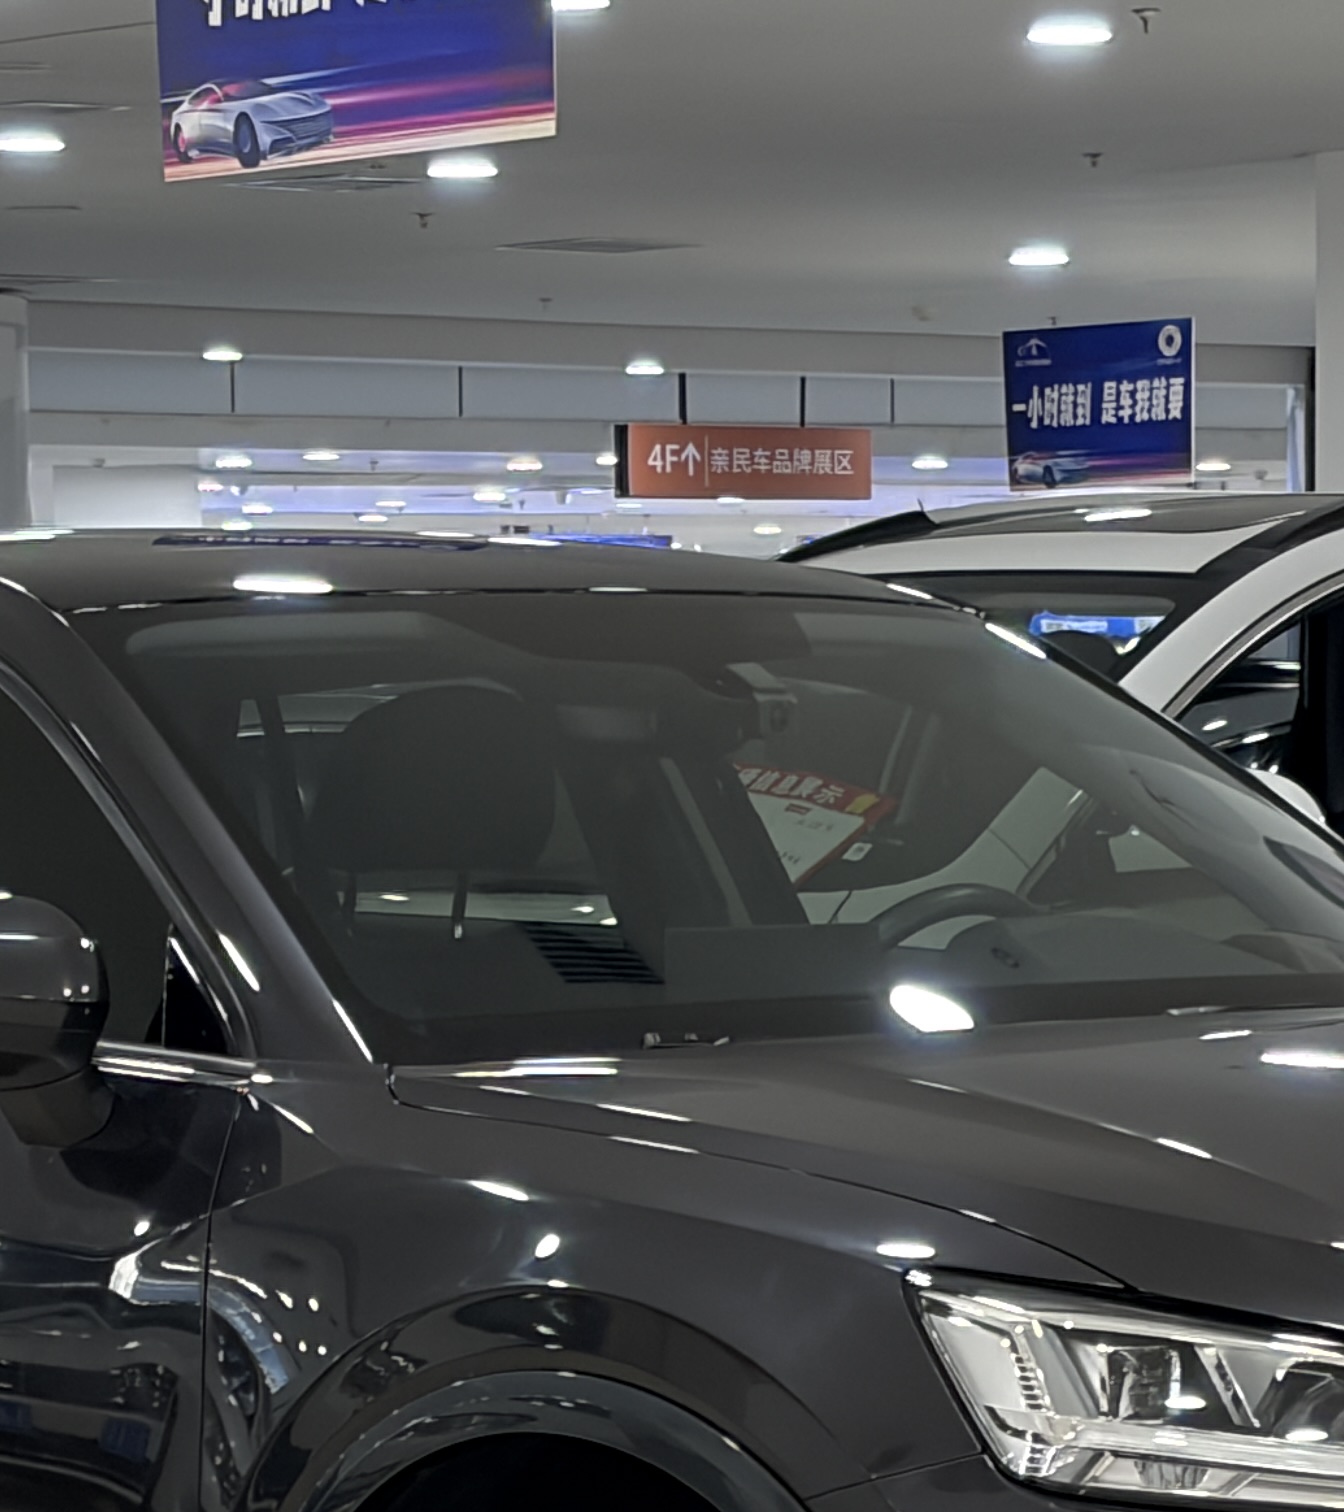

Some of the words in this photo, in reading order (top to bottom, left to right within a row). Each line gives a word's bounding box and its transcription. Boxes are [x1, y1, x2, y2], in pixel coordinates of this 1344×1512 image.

[1012, 382, 1092, 429] 一小时就到
[1101, 376, 1185, 425] 是车我就要
[647, 444, 680, 474] 4F
[710, 447, 855, 475] 亲民车品牌展区
